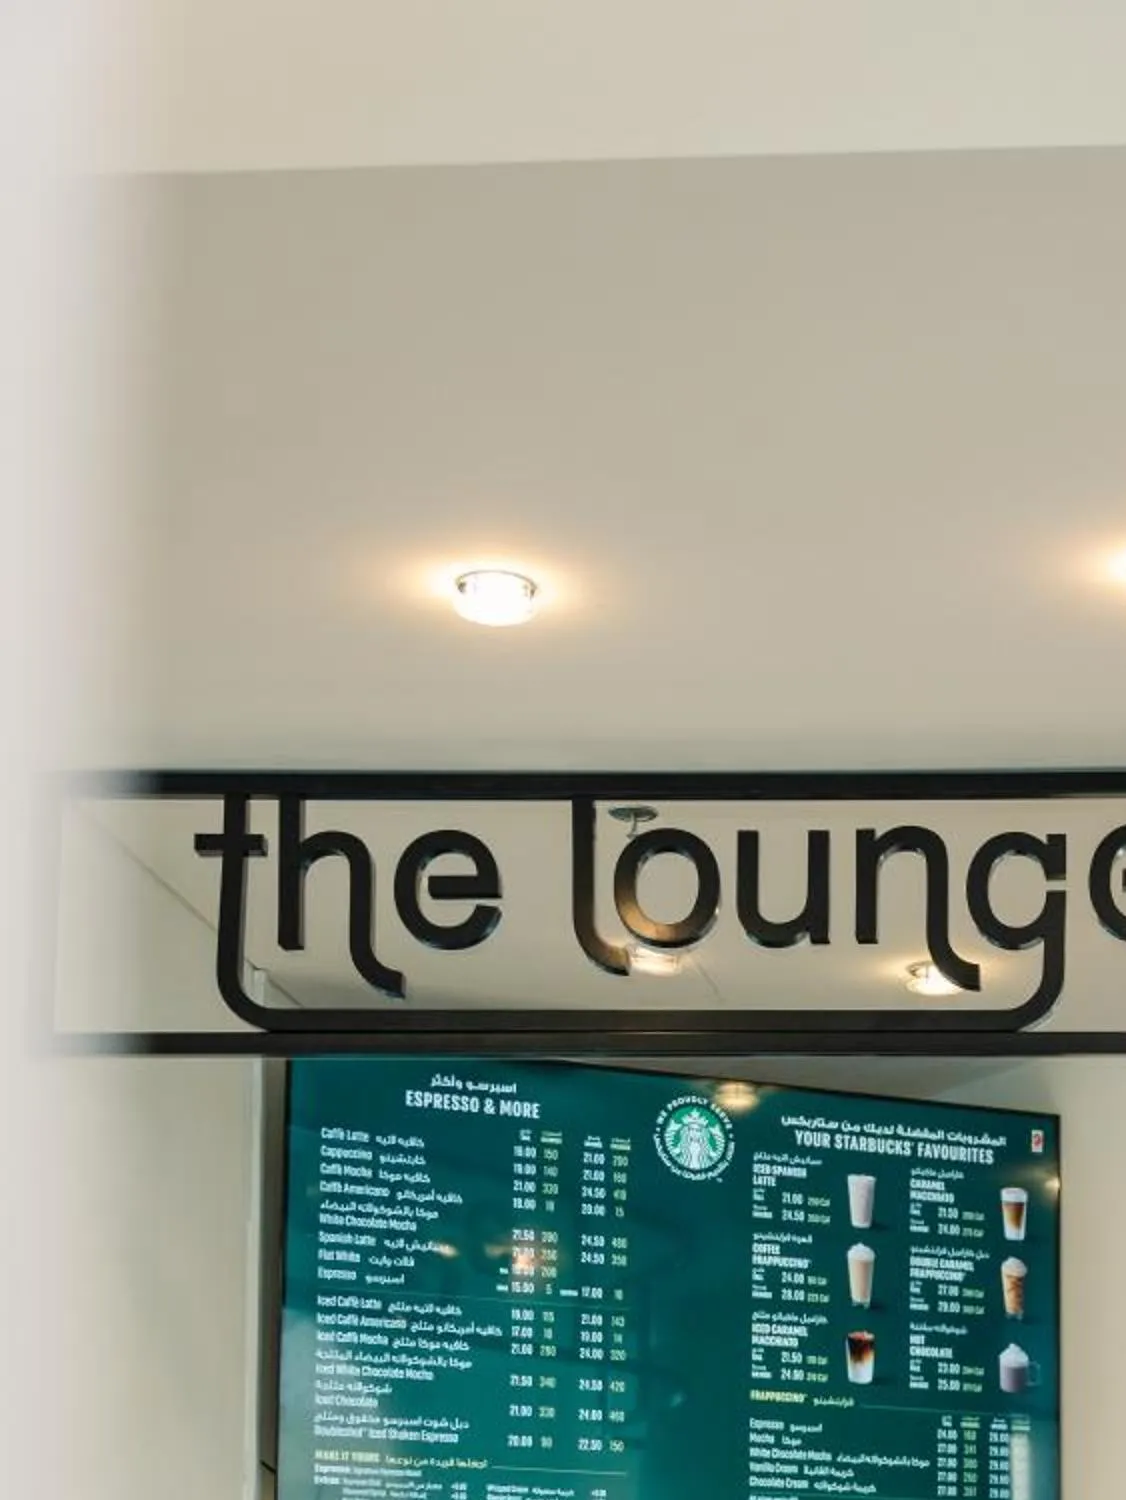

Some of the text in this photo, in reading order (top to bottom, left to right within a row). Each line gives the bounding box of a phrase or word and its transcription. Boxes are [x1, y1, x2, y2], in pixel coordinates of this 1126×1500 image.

[194, 795, 502, 1030] the
[405, 1090, 540, 1120] ESPRESSO & MORE
[347, 1130, 369, 1142] Latte
[320, 1145, 373, 1161] Cappuccino
[795, 1130, 830, 1149] YOUR
[918, 1144, 994, 1165] FAVOURITES
[344, 1165, 373, 1178] Mocha
[752, 1176, 776, 1186] LATTE
[910, 1178, 945, 1190] CARAMEL
[344, 1184, 390, 1197] Americano
[320, 1213, 416, 1231] White Chocolate Mocha
[318, 1231, 376, 1246] Spanish Latte
[318, 1249, 360, 1262] Flat White
[752, 1243, 780, 1255] COFFEE
[318, 1266, 356, 1280] Espresso
[318, 1295, 336, 1307] Iced
[360, 1298, 382, 1309] Latte
[317, 1313, 336, 1325] Iced
[360, 1316, 407, 1329] Americano
[752, 1323, 808, 1337] ICED CARAMEL
[317, 1331, 335, 1342] Iced
[360, 1333, 388, 1346] Mocha
[910, 1334, 925, 1344] HOT
[909, 1346, 953, 1358] CHOCOLATE
[316, 1363, 434, 1380] Iced White Chocolate Mocha
[315, 1393, 378, 1408] Iced Chocolate
[750, 1418, 784, 1432] Espresso
[422, 1431, 458, 1443] Espresso
[750, 1433, 775, 1444] Mocha
[750, 1447, 832, 1461] White Chocolate Mocha
[750, 1462, 798, 1474] Vanilla Cream
[750, 1476, 808, 1489] Chocolate Cream
